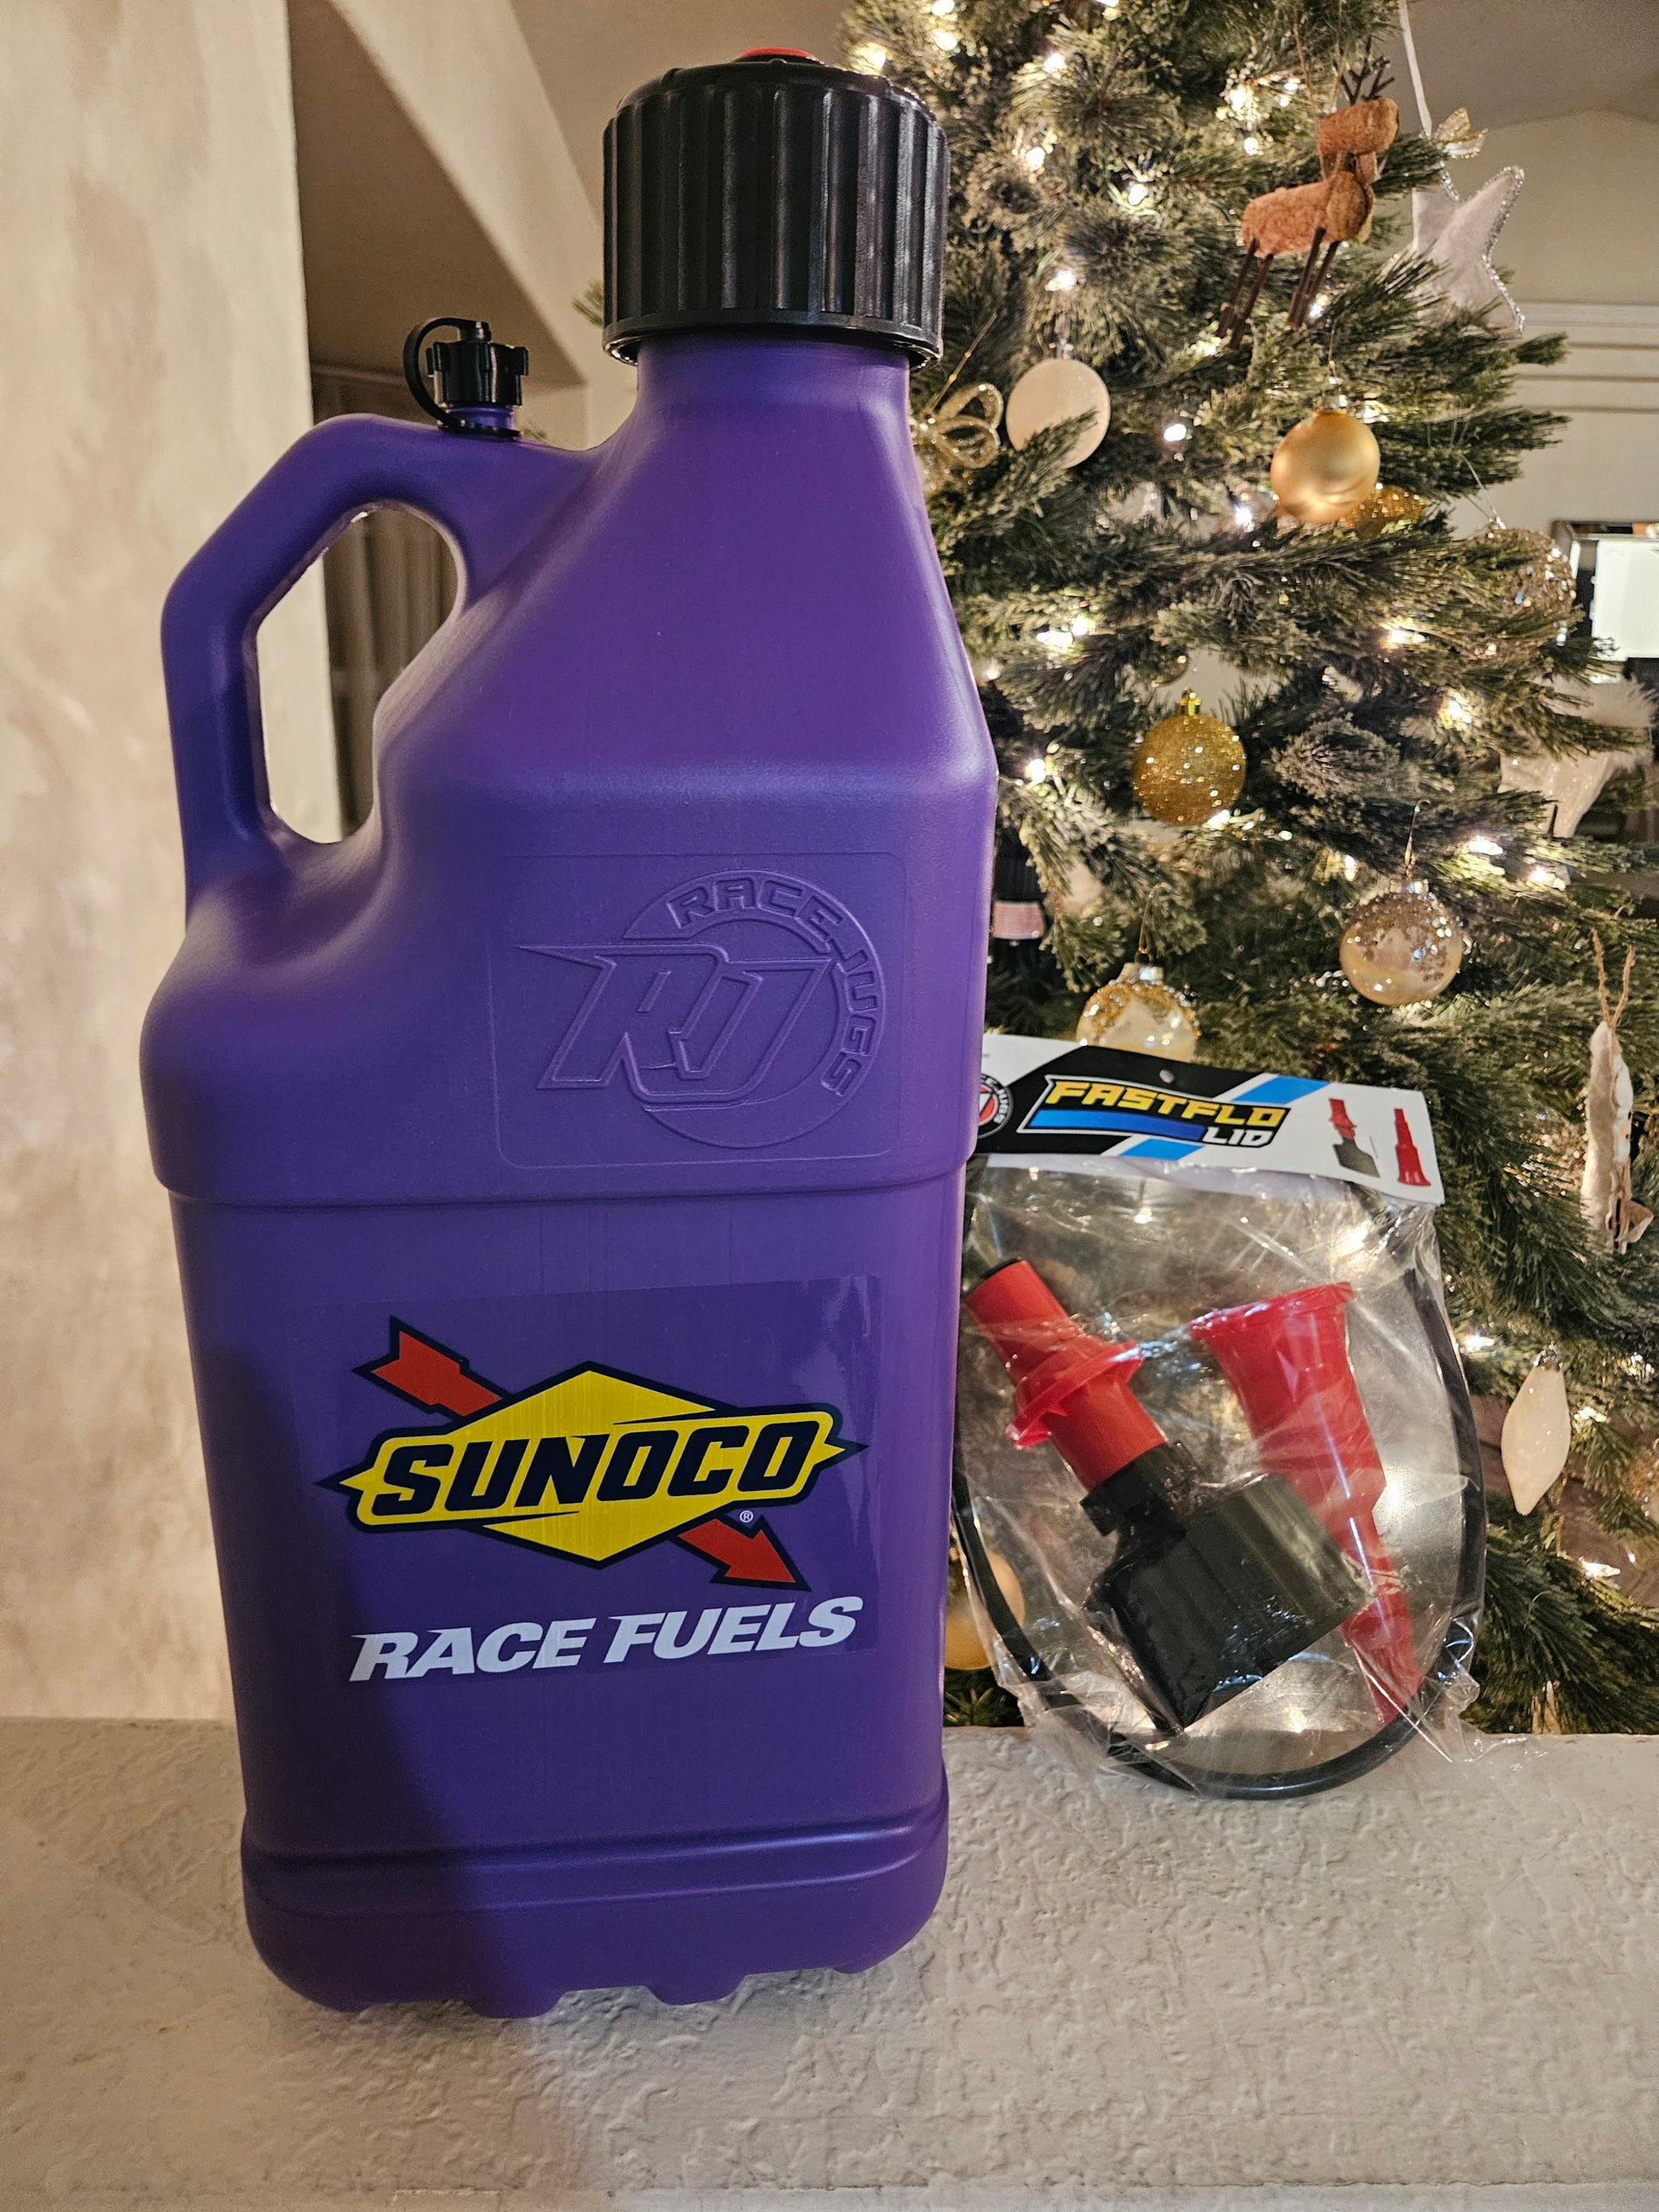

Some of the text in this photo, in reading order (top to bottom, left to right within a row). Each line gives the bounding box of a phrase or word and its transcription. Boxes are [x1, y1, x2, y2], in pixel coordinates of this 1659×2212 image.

[667, 876, 878, 1097] RACE JUGS
[1045, 1081, 1286, 1125] FASTFLO
[1203, 1125, 1274, 1147] LID
[371, 1420, 819, 1516] SUNOCO
[349, 1596, 864, 1682] RACE FUELS
